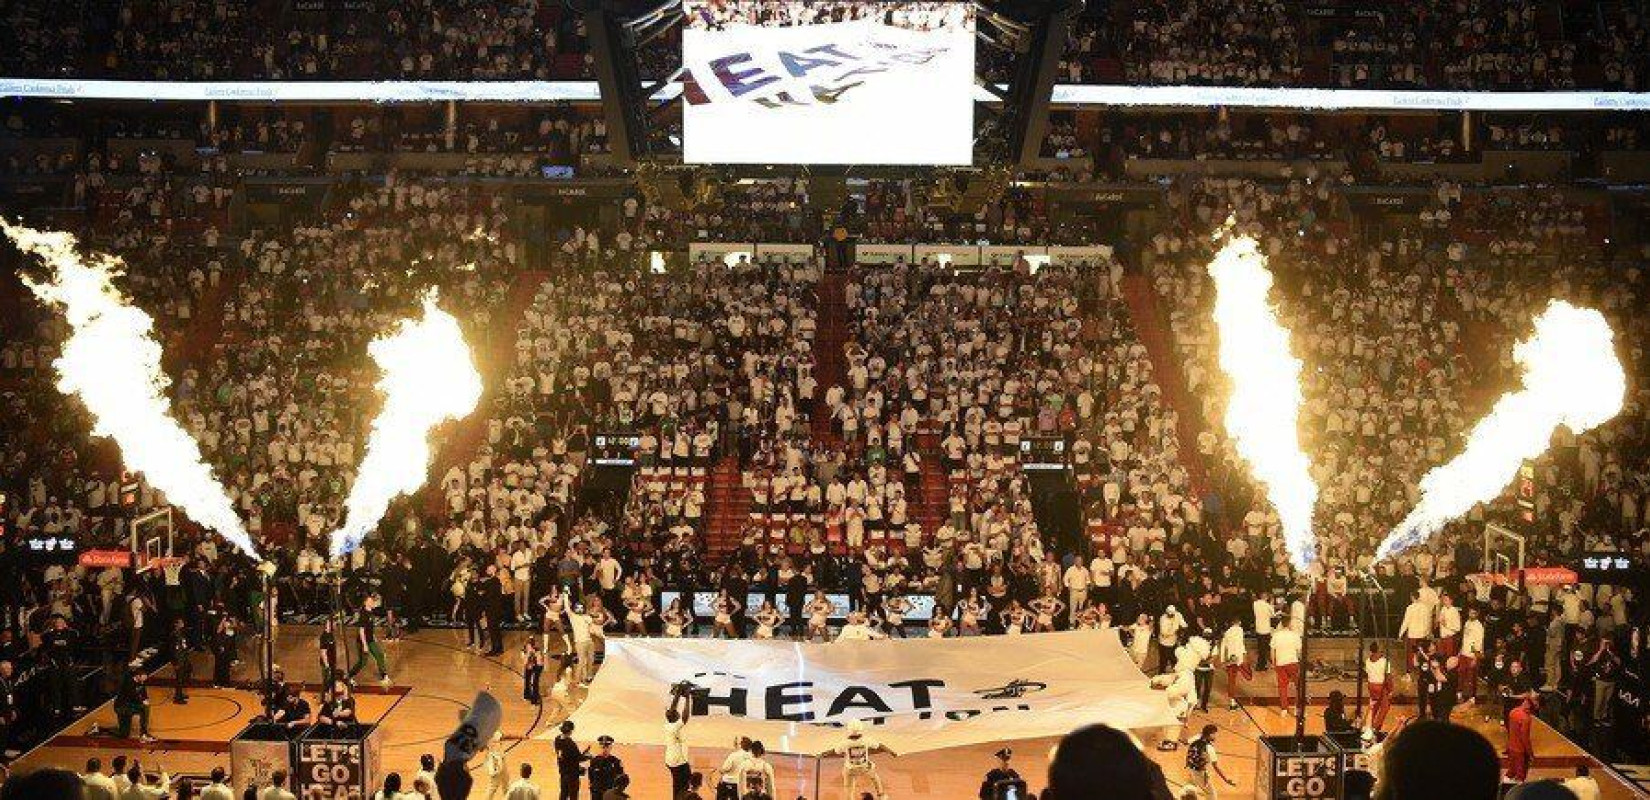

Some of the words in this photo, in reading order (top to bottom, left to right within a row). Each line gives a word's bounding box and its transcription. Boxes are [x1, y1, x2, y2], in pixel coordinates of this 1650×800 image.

[690, 679, 945, 721] HEAT
[301, 744, 360, 763] LET'S
[312, 764, 349, 784] GO
[1276, 757, 1336, 776] LET'S
[1287, 777, 1325, 797] GO
